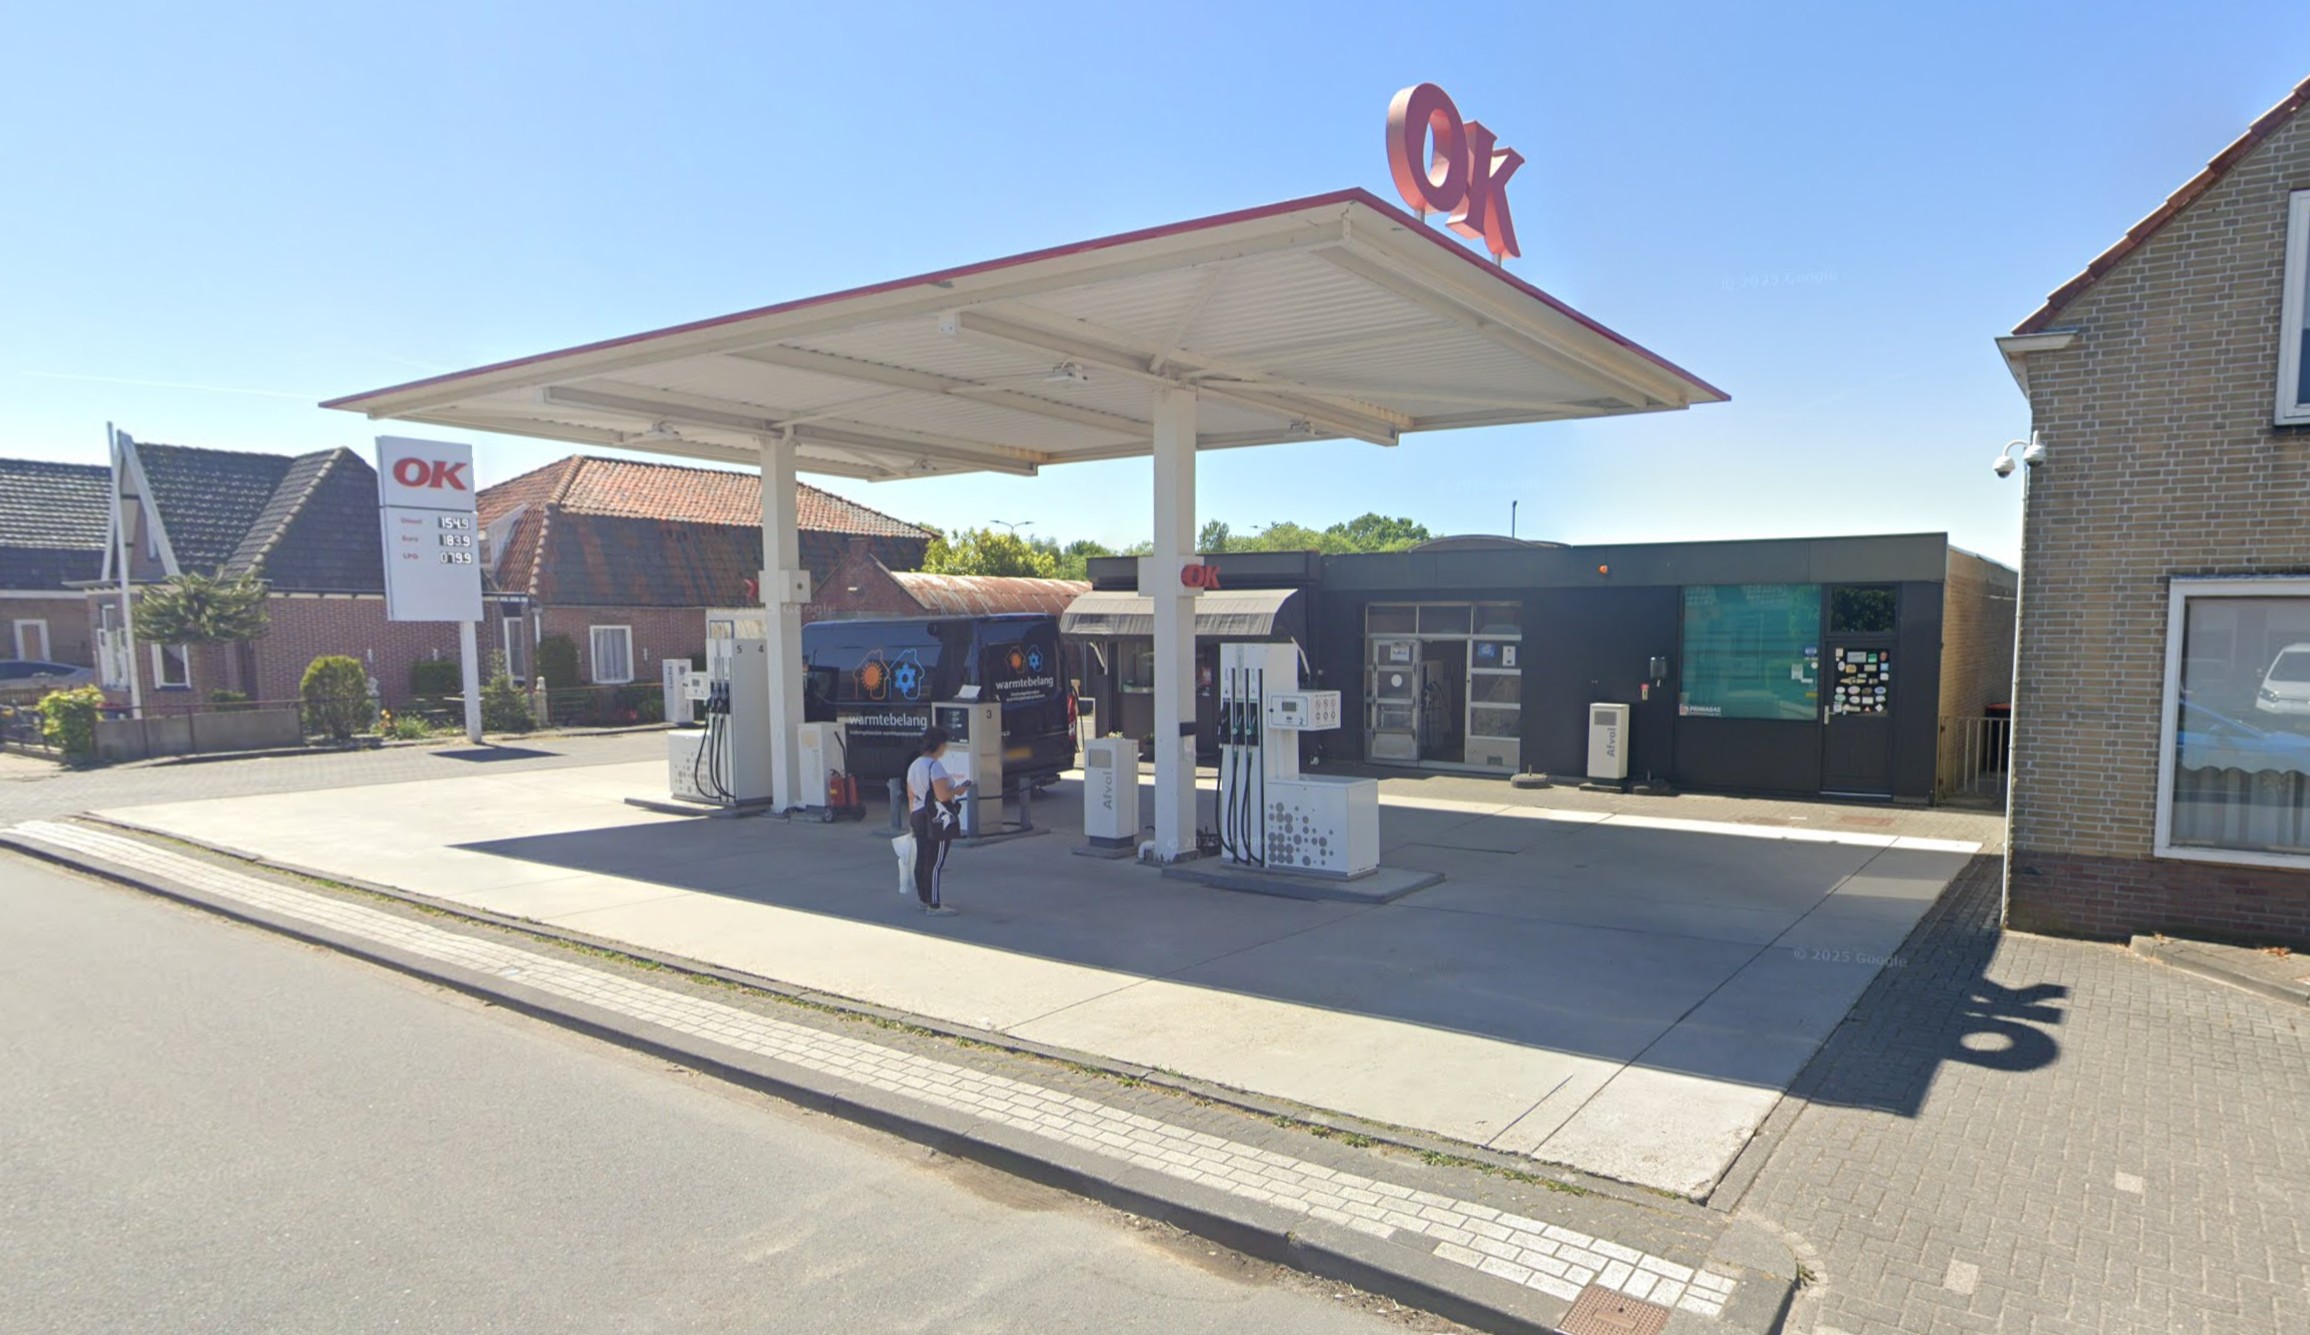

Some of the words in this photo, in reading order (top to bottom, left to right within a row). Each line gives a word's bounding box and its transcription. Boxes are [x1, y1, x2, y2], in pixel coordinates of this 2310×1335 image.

[1386, 82, 1525, 259] OK
[393, 457, 467, 490] OK
[1181, 564, 1221, 589] OK
[737, 645, 743, 654] 5
[995, 676, 1054, 690] warmtebelang
[849, 712, 927, 731] warmtebelang
[986, 709, 992, 719] 3
[1606, 727, 1616, 757] Afval
[1102, 770, 1112, 810] Afval
